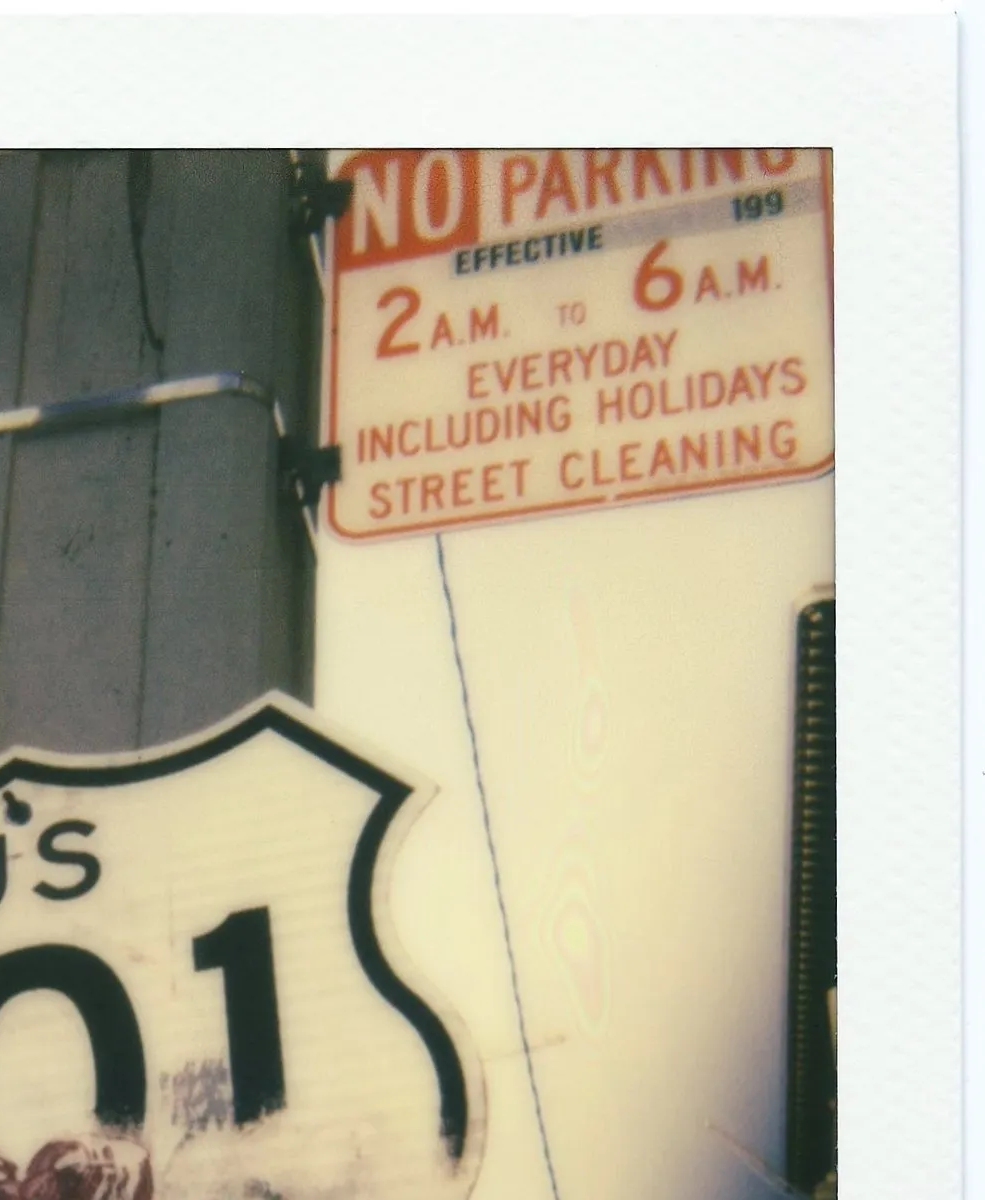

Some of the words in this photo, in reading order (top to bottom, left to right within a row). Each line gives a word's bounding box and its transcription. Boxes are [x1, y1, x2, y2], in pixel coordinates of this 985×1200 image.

[352, 149, 465, 254] NO
[454, 225, 604, 275] EFFECTIVE
[731, 189, 783, 222] 199
[556, 302, 587, 327] TO
[356, 395, 573, 464] INCLUDING
[596, 357, 807, 425] HOLIDAYS
[466, 330, 679, 400] EVERYDAY
[368, 459, 532, 520] STREET
[559, 420, 797, 491] CLEANING
